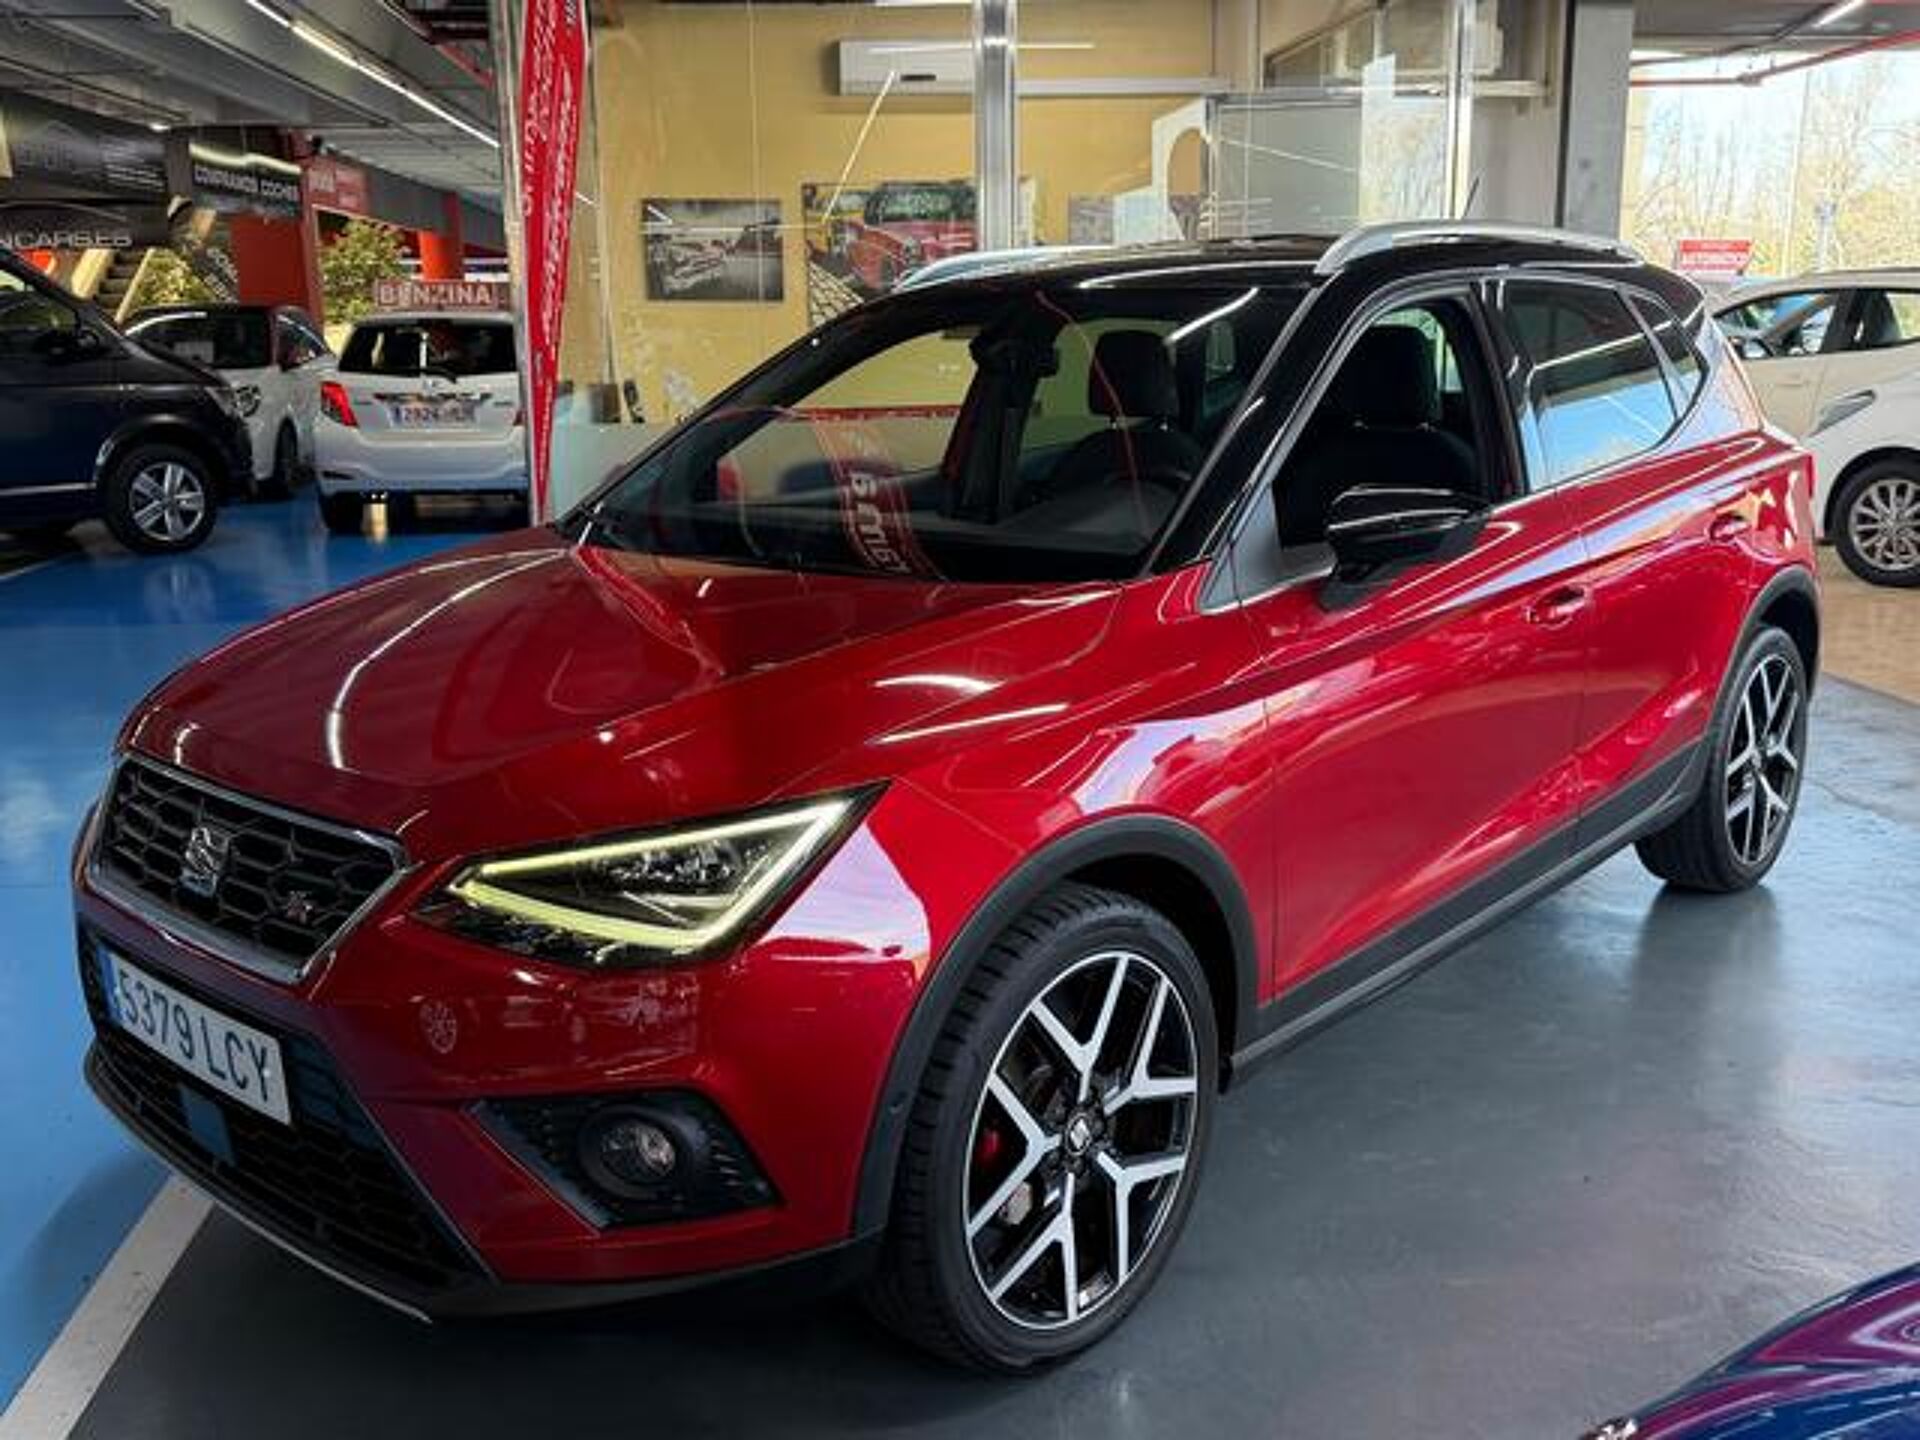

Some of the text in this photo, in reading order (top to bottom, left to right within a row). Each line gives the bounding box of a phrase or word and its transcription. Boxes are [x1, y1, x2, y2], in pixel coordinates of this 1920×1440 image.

[379, 281, 492, 305] BENZINA
[119, 968, 268, 1103] 5379 LCY
